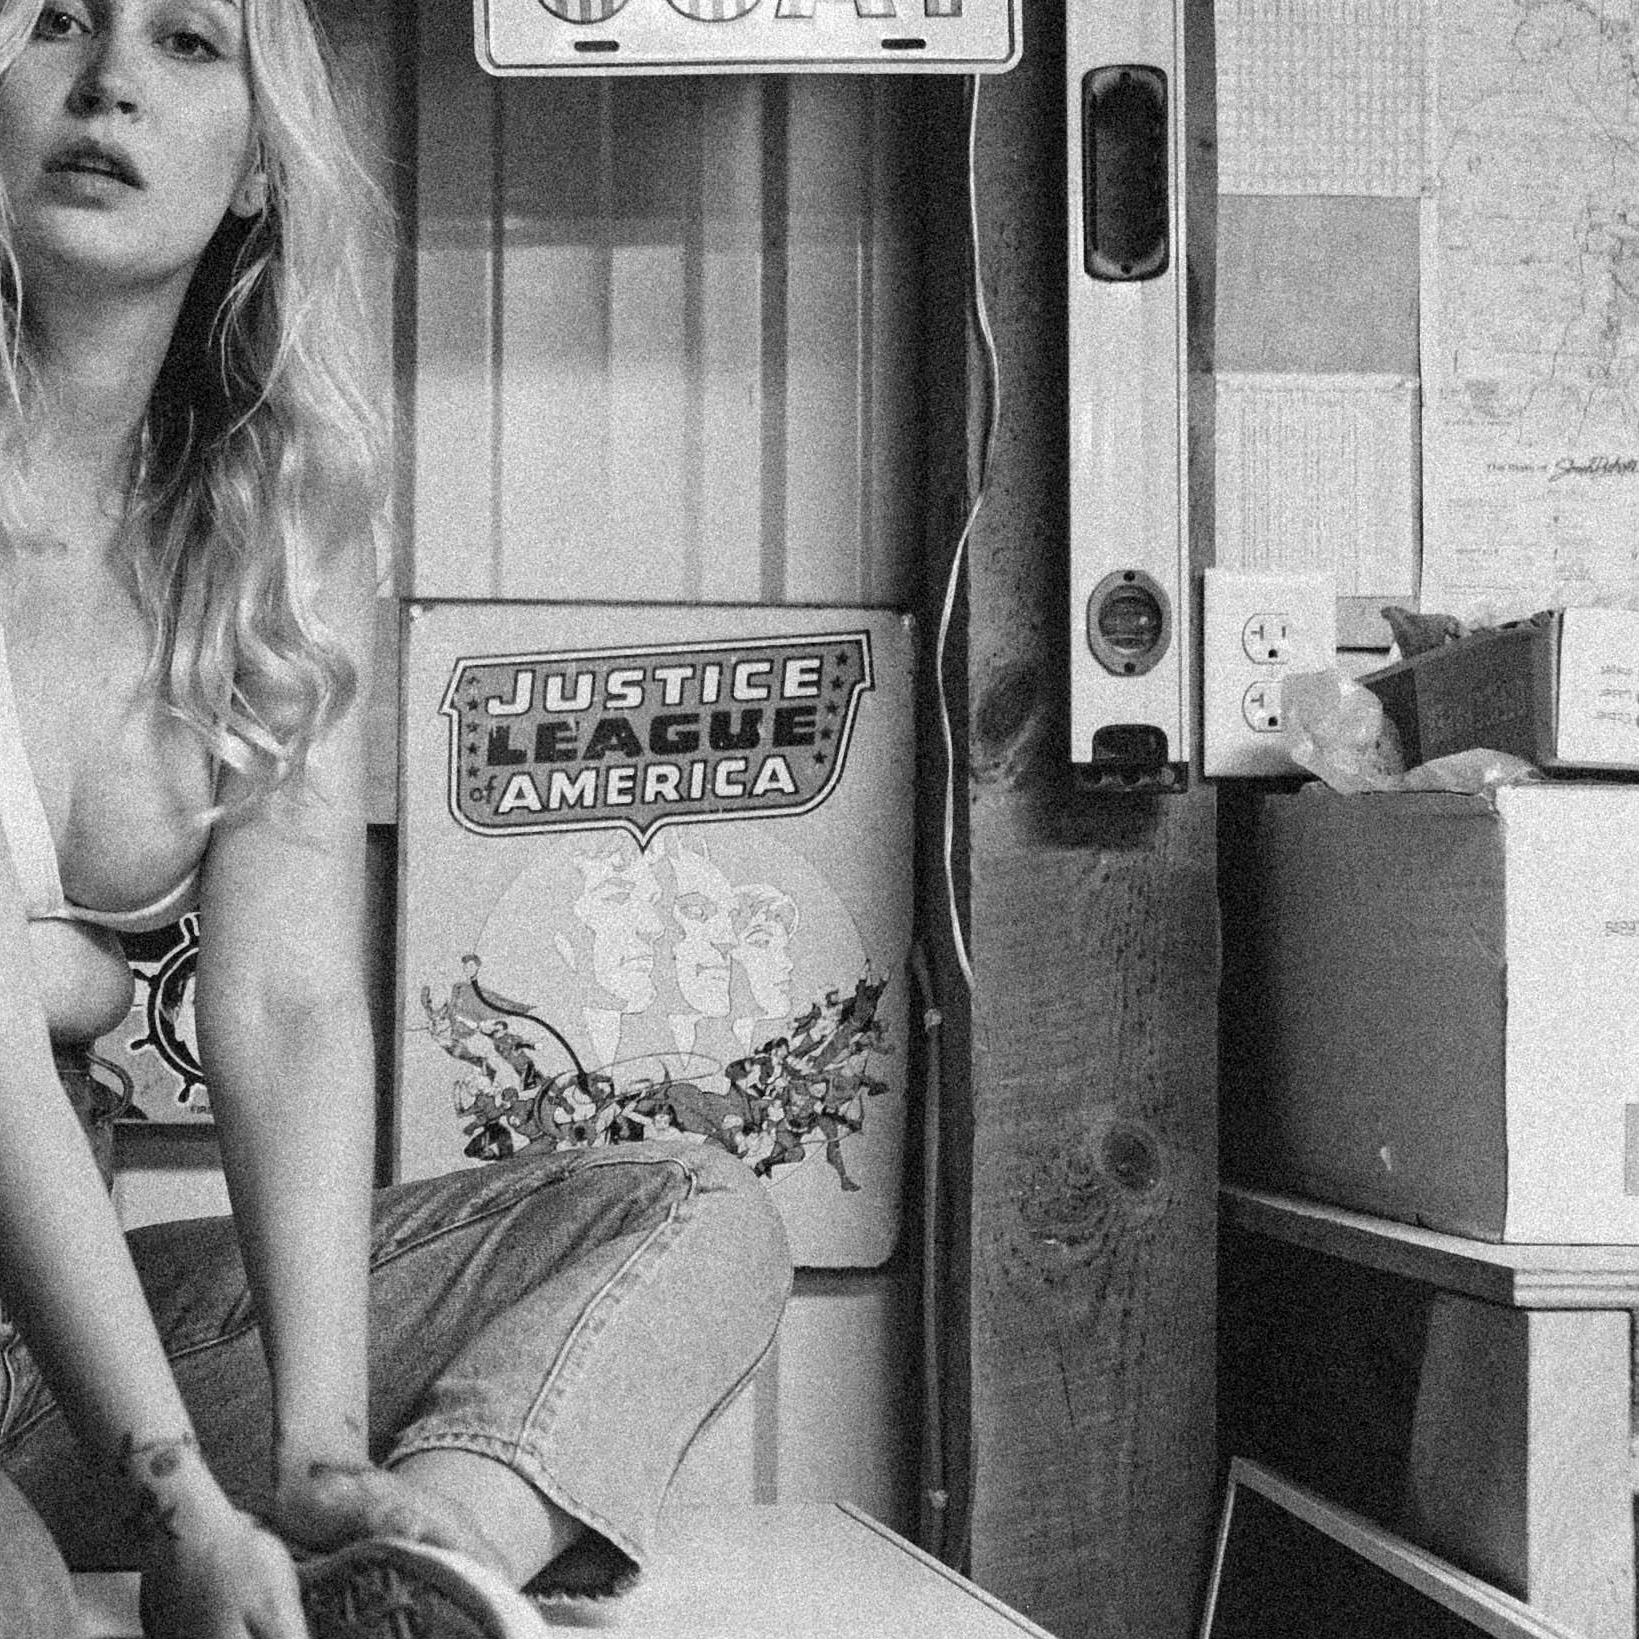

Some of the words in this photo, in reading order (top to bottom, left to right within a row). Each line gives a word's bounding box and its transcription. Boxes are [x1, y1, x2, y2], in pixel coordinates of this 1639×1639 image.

[484, 654, 824, 718] JUSTICE
[485, 704, 819, 768] LEAGUE
[468, 774, 498, 805] of
[496, 752, 800, 816] AMERICA
